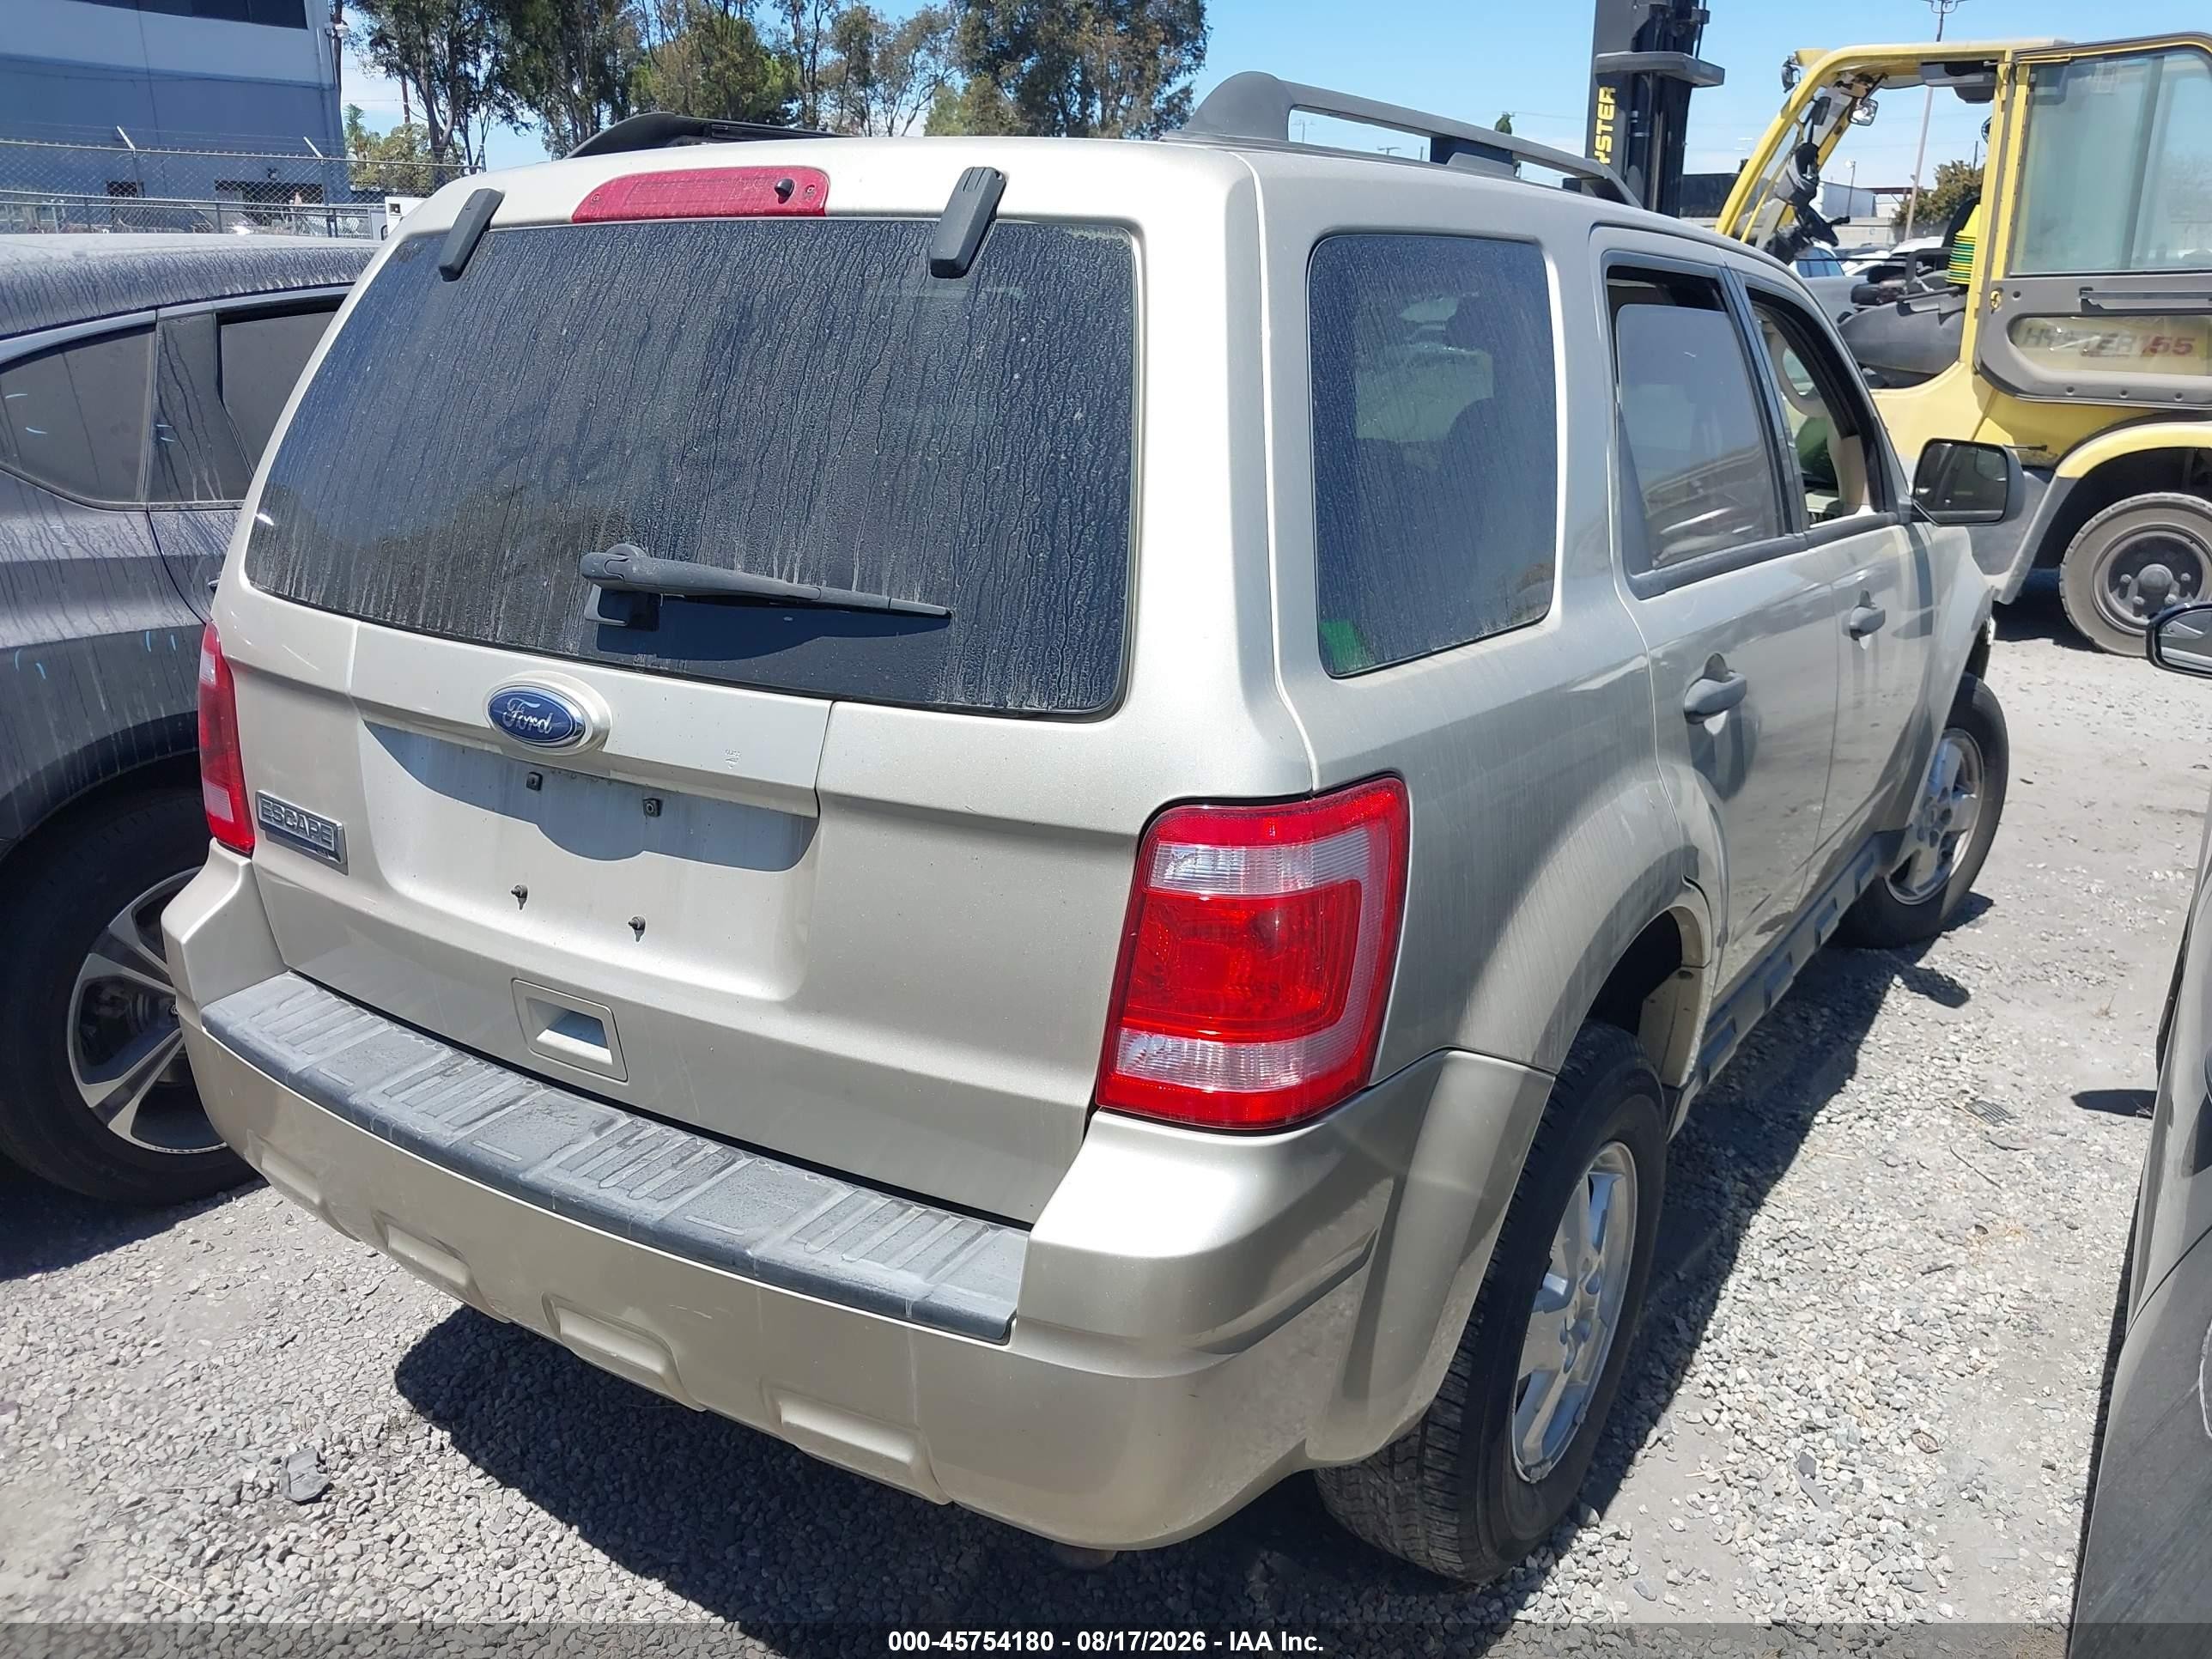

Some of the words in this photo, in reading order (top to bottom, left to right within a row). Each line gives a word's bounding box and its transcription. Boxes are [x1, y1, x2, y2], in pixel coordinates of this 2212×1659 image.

[1595, 87, 1616, 164] YSTER
[501, 697, 554, 734] Ford
[260, 798, 335, 851] ESCAPE
